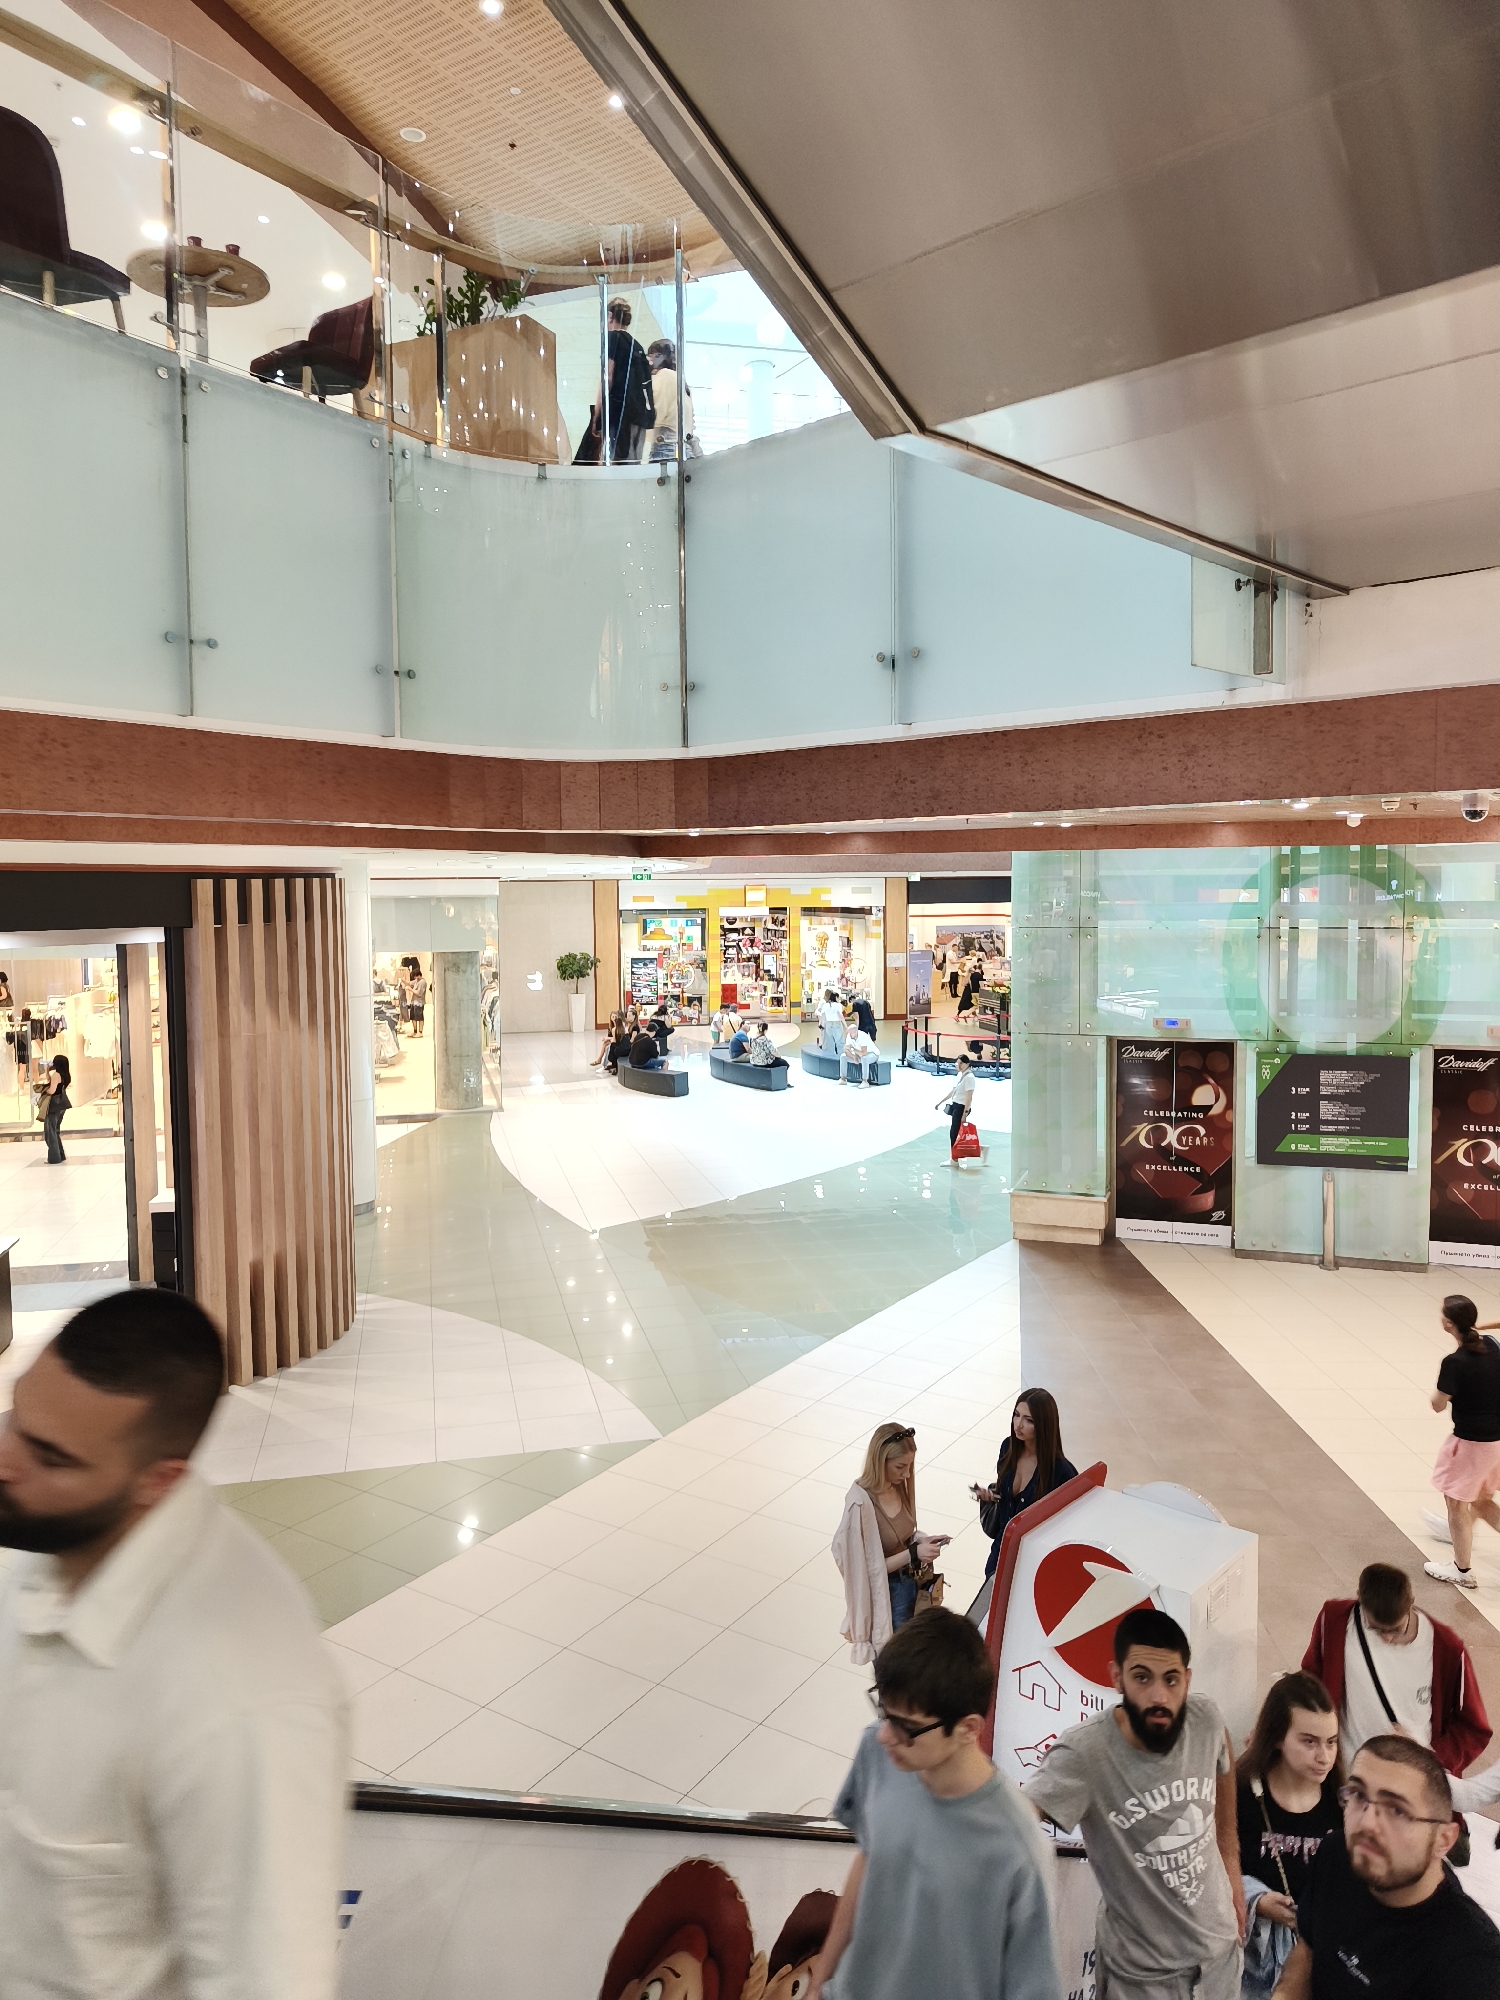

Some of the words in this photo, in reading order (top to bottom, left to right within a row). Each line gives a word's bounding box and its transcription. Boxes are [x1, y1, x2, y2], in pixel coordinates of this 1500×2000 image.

[1121, 1045, 1172, 1061] Davidoff
[1438, 1055, 1498, 1071] Davidoff
[1143, 1109, 1204, 1119] CELEBRATING
[1181, 1135, 1215, 1147] YEARS
[1145, 1164, 1201, 1173] EXCELLENCE
